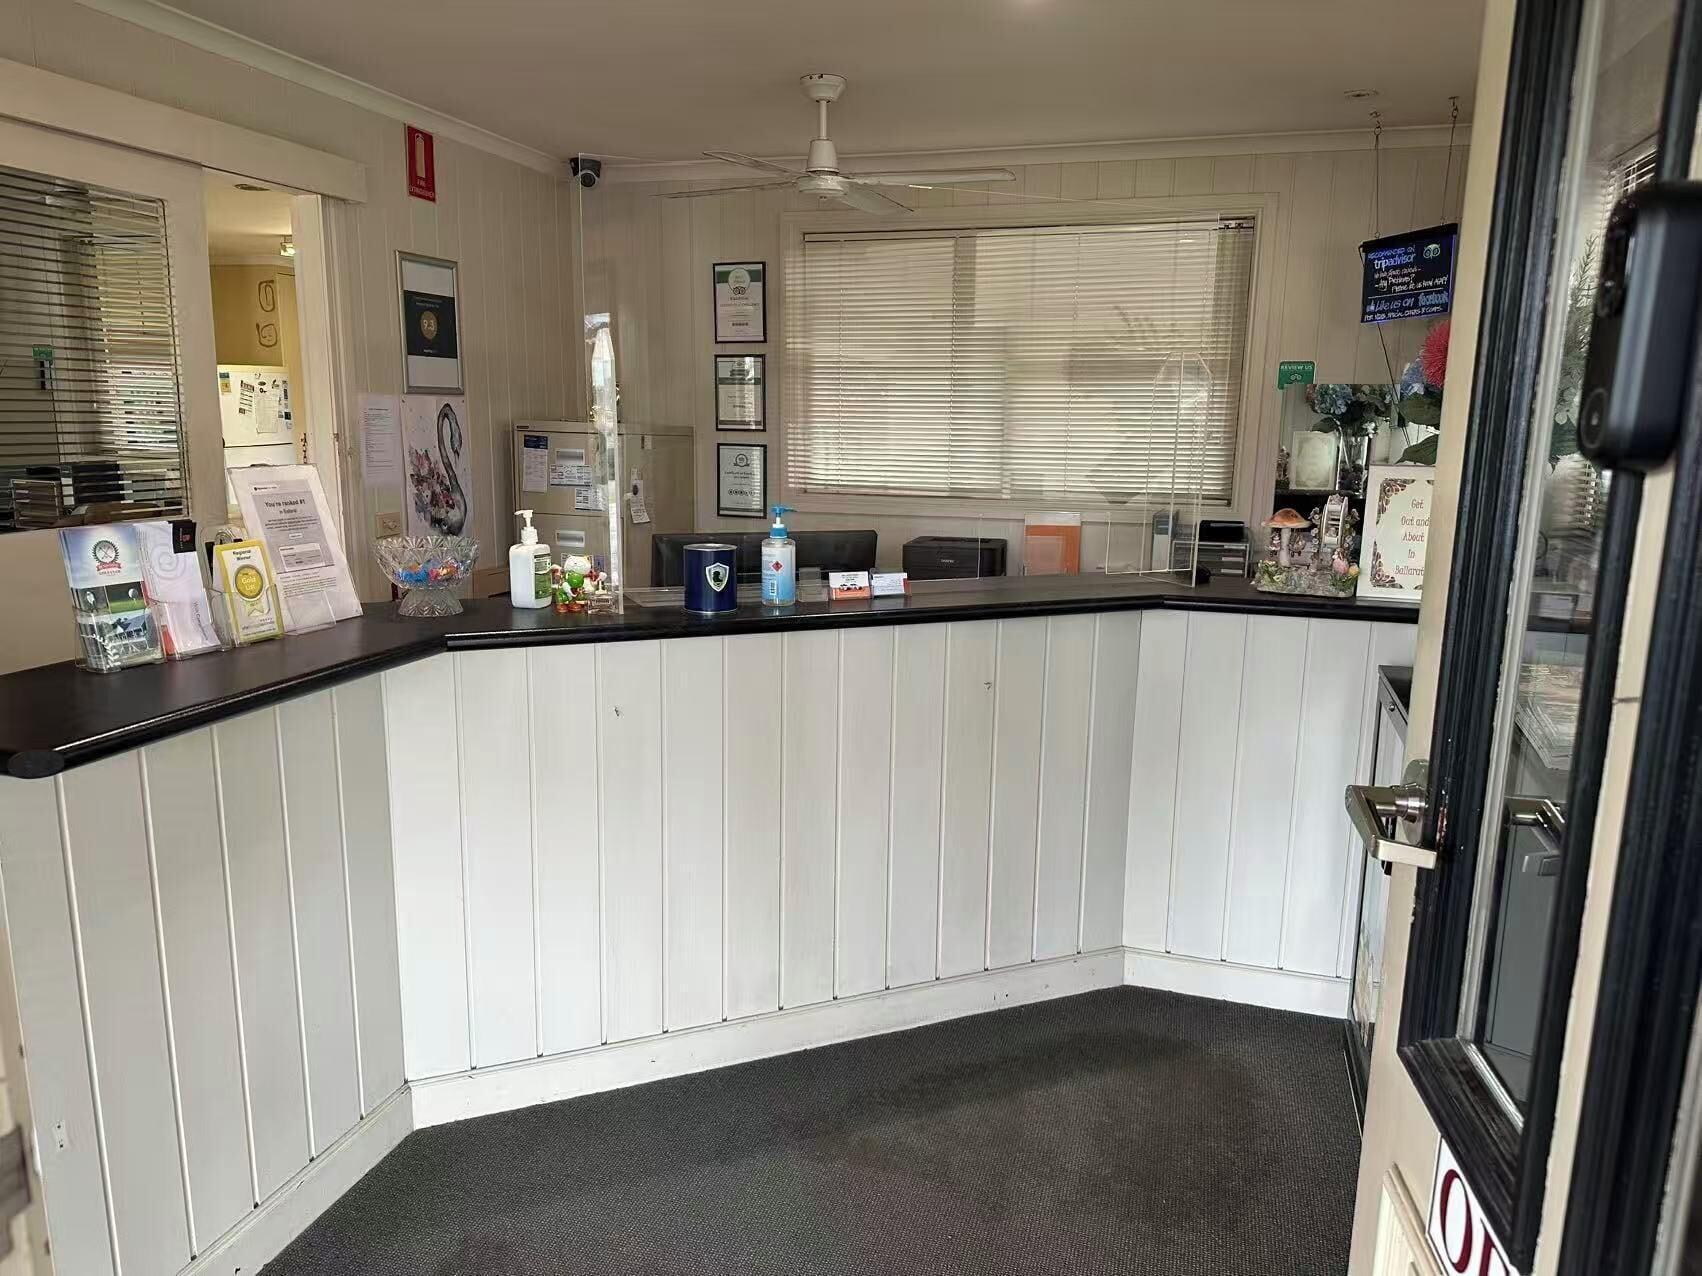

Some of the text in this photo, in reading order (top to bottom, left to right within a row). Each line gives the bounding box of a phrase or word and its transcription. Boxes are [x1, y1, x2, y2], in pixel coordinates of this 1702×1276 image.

[1374, 253, 1416, 272] tripadvisor
[1411, 499, 1424, 509] Get
[1401, 515, 1430, 527] Out and
[1402, 532, 1425, 542] About
[1407, 549, 1415, 559] In
[241, 576, 256, 584] Gold
